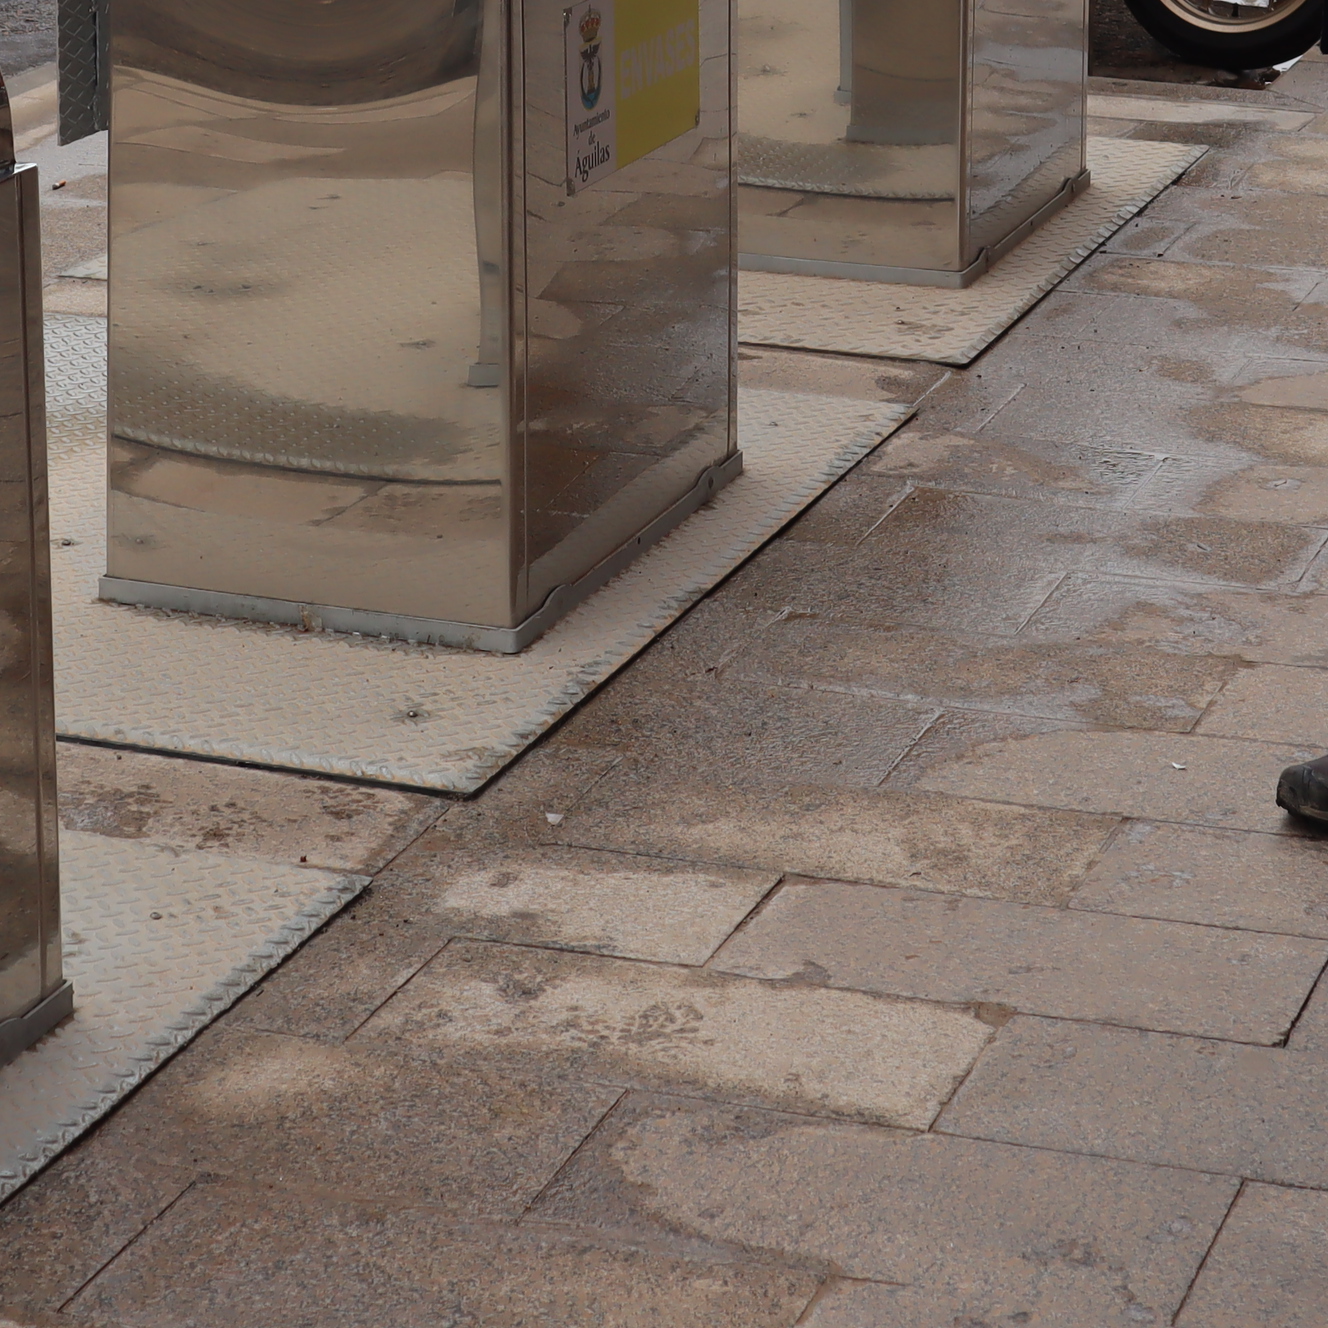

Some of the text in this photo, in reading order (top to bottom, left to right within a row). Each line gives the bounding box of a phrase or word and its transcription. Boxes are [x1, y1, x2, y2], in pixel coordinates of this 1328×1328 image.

[621, 18, 696, 100] ENVASES
[573, 108, 610, 138] Ayuntamiento
[588, 130, 596, 146] de
[574, 142, 610, 183] Águilas
